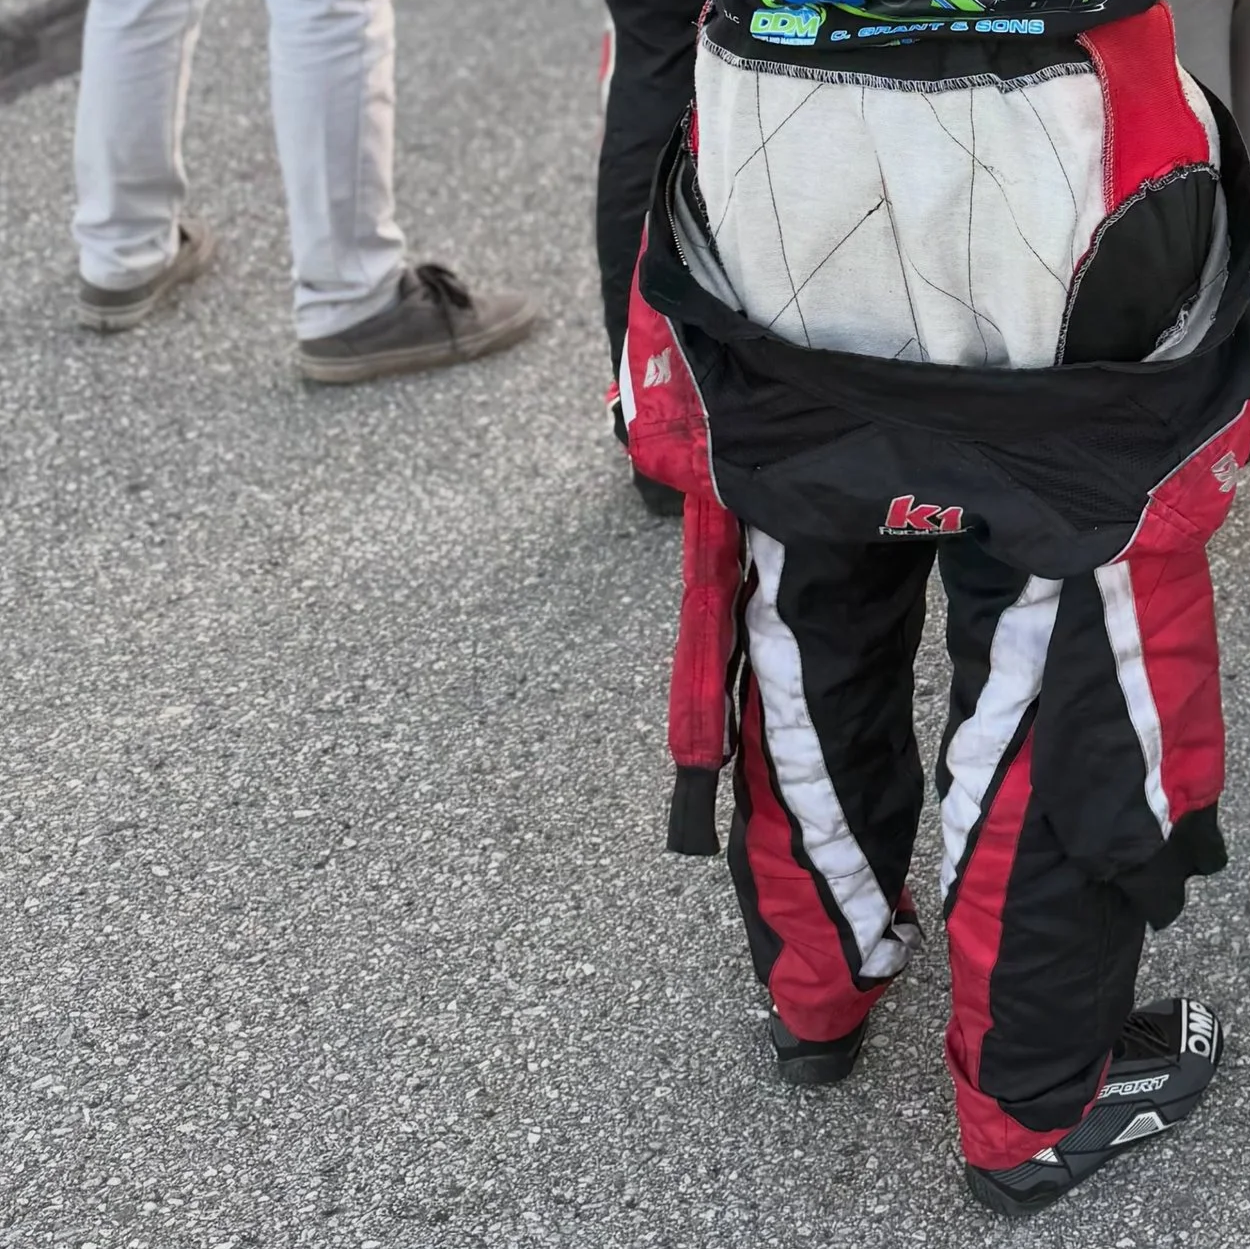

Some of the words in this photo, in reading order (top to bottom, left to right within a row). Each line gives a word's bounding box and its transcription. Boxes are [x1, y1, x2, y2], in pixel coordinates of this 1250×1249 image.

[750, 12, 820, 38] DDM
[858, 22, 945, 38] GRANT
[950, 21, 969, 32] &
[975, 19, 1046, 35] SONS
[1188, 1001, 1213, 1057] OMP
[1098, 1074, 1169, 1100] SPORT
